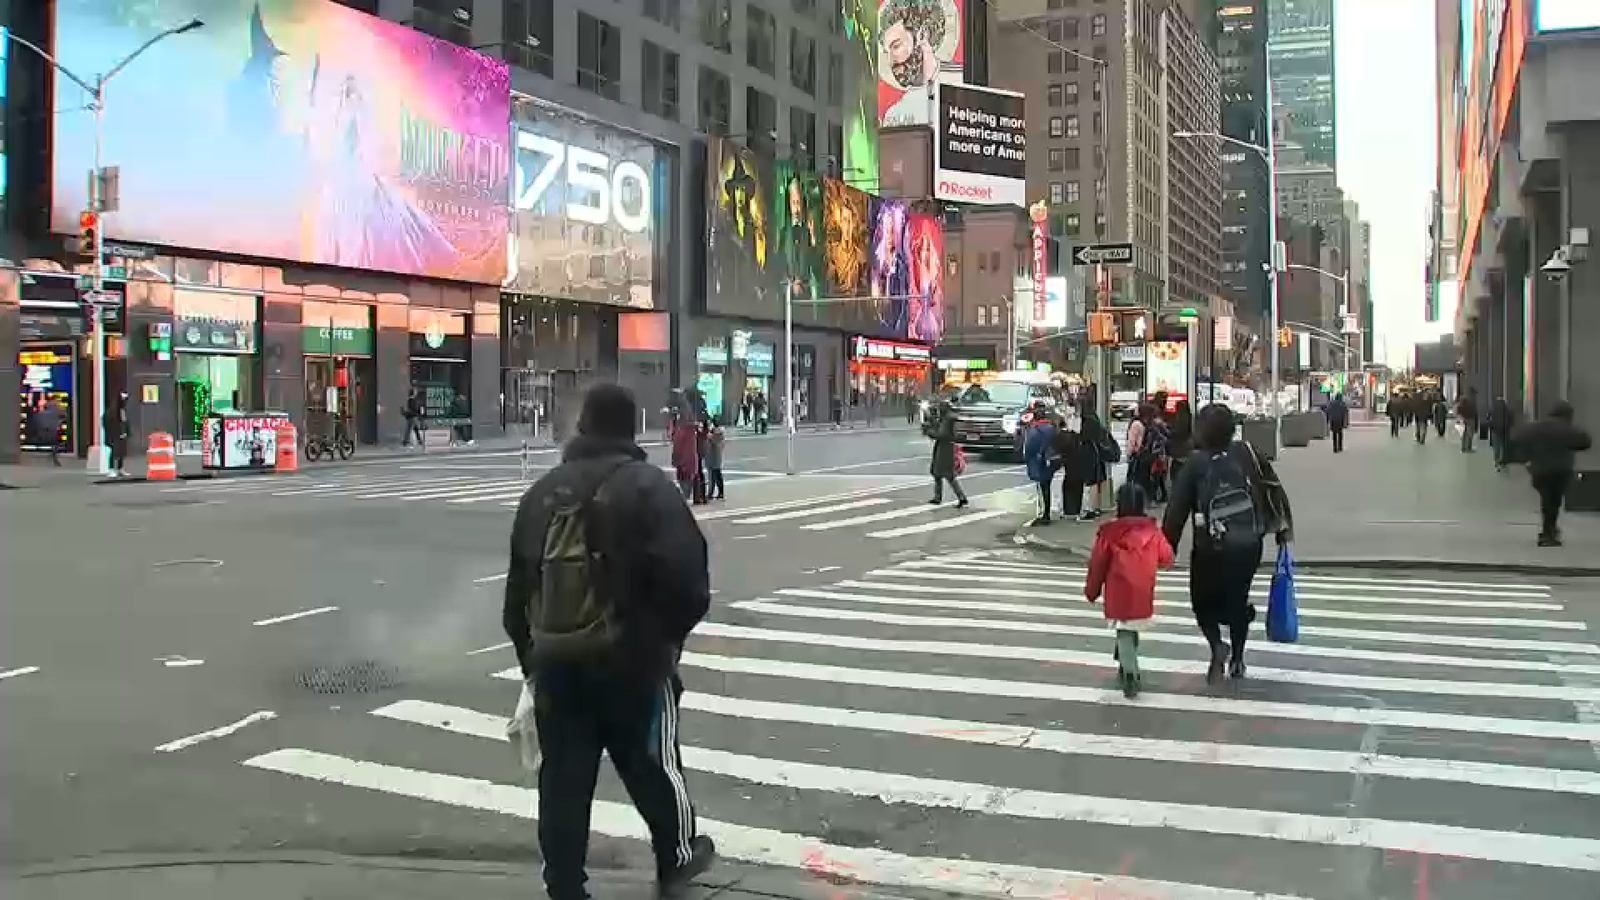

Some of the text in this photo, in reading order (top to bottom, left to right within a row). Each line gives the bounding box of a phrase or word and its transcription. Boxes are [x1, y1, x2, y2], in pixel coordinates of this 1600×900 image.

[949, 106, 996, 127] Helping
[948, 122, 1012, 142] Americans
[949, 141, 980, 154] more
[983, 143, 996, 156] of
[518, 129, 650, 233] 750
[951, 182, 993, 199] Rocket
[1108, 249, 1127, 258] WAY
[320, 328, 354, 340] COFFEE
[225, 417, 288, 432] CHICAGO
